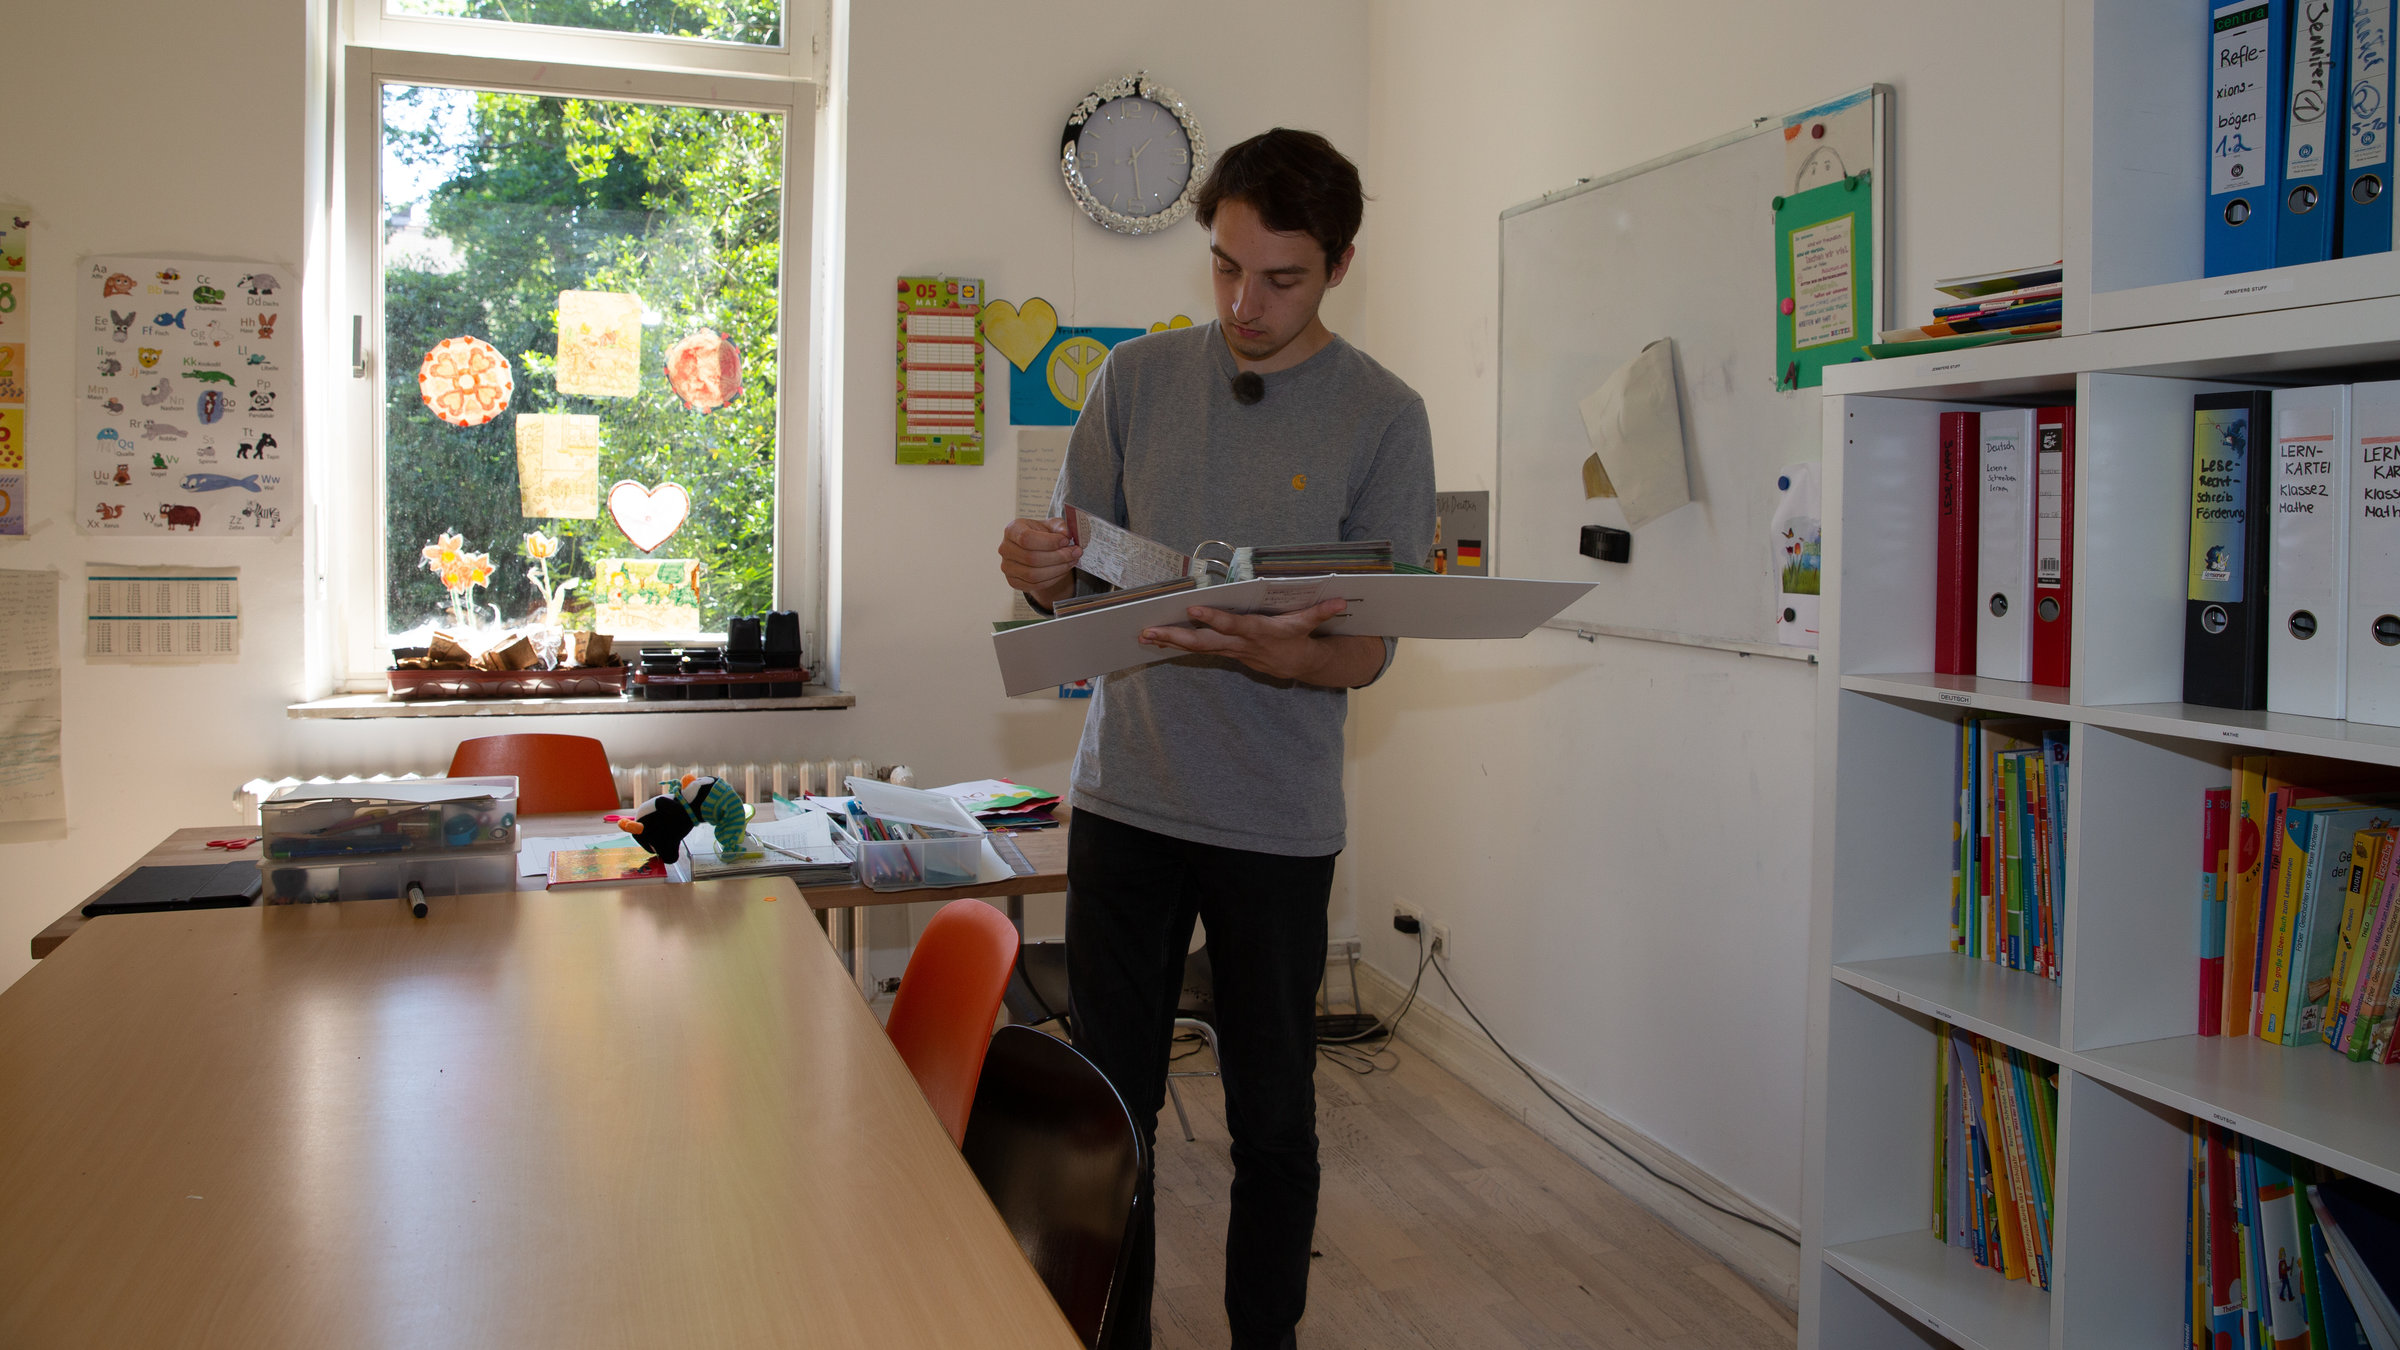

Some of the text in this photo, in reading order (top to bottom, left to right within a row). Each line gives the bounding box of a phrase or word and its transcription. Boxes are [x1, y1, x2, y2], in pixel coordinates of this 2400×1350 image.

[2216, 7, 2265, 30] centra
[2306, 2, 2336, 89] Jennifer
[2220, 45, 2266, 68] Refle-
[2217, 82, 2253, 99] xions-
[2218, 112, 2256, 130] bögen
[2215, 133, 2252, 157] 1.2
[1172, 147, 1188, 165] 3
[93, 264, 107, 274] Aa
[197, 275, 211, 284] Cc
[148, 285, 162, 294] Bb
[916, 284, 937, 298] 05
[247, 296, 261, 306] Dd
[95, 316, 108, 325] Ee
[240, 318, 255, 327] Hh
[142, 326, 153, 336] Ff
[191, 329, 205, 340] Gg
[183, 357, 197, 366] Kk
[88, 385, 108, 394] Mm
[257, 380, 271, 389] Pp
[170, 396, 184, 405] Nn
[130, 420, 141, 428] Rr
[243, 428, 253, 437] Tt
[118, 440, 134, 450] Qq
[203, 435, 215, 444] Ss
[1986, 440, 2015, 453] Deutsch
[2281, 445, 2323, 458] LERN-
[167, 455, 179, 463] Vv
[1986, 464, 2002, 472] Lesen
[2202, 458, 2240, 473] Lese-
[2286, 461, 2331, 476] KARTEI
[94, 470, 109, 480] Uu
[261, 475, 280, 484] Ww
[2280, 484, 2317, 496] Klasse
[2364, 488, 2400, 500] Klass
[2279, 501, 2314, 514] Mathe
[143, 512, 156, 523] Yy
[230, 516, 242, 525] Zz
[2196, 507, 2245, 524] Förderung
[87, 520, 99, 528] Xx
[2274, 816, 2282, 851] Lesebuch
[2243, 833, 2254, 856] 4
[2376, 844, 2391, 879] Leserabe
[2299, 892, 2309, 928] Geschichten
[2304, 869, 2312, 880] der
[2308, 824, 2319, 851] Hortense
[2332, 866, 2348, 878] der
[2353, 870, 2361, 892] DUDEN
[2272, 980, 2280, 992] Das
[2283, 857, 2293, 898] Lesenlernen
[2371, 948, 2388, 983] Geschichten
[2382, 934, 2391, 947] vom
[2002, 1094, 2010, 1120] Schreiben
[2011, 1155, 2021, 1184] Schuljahr
[2020, 1204, 2028, 1223] durch
[2023, 1224, 2033, 1258] Erfolgreich
